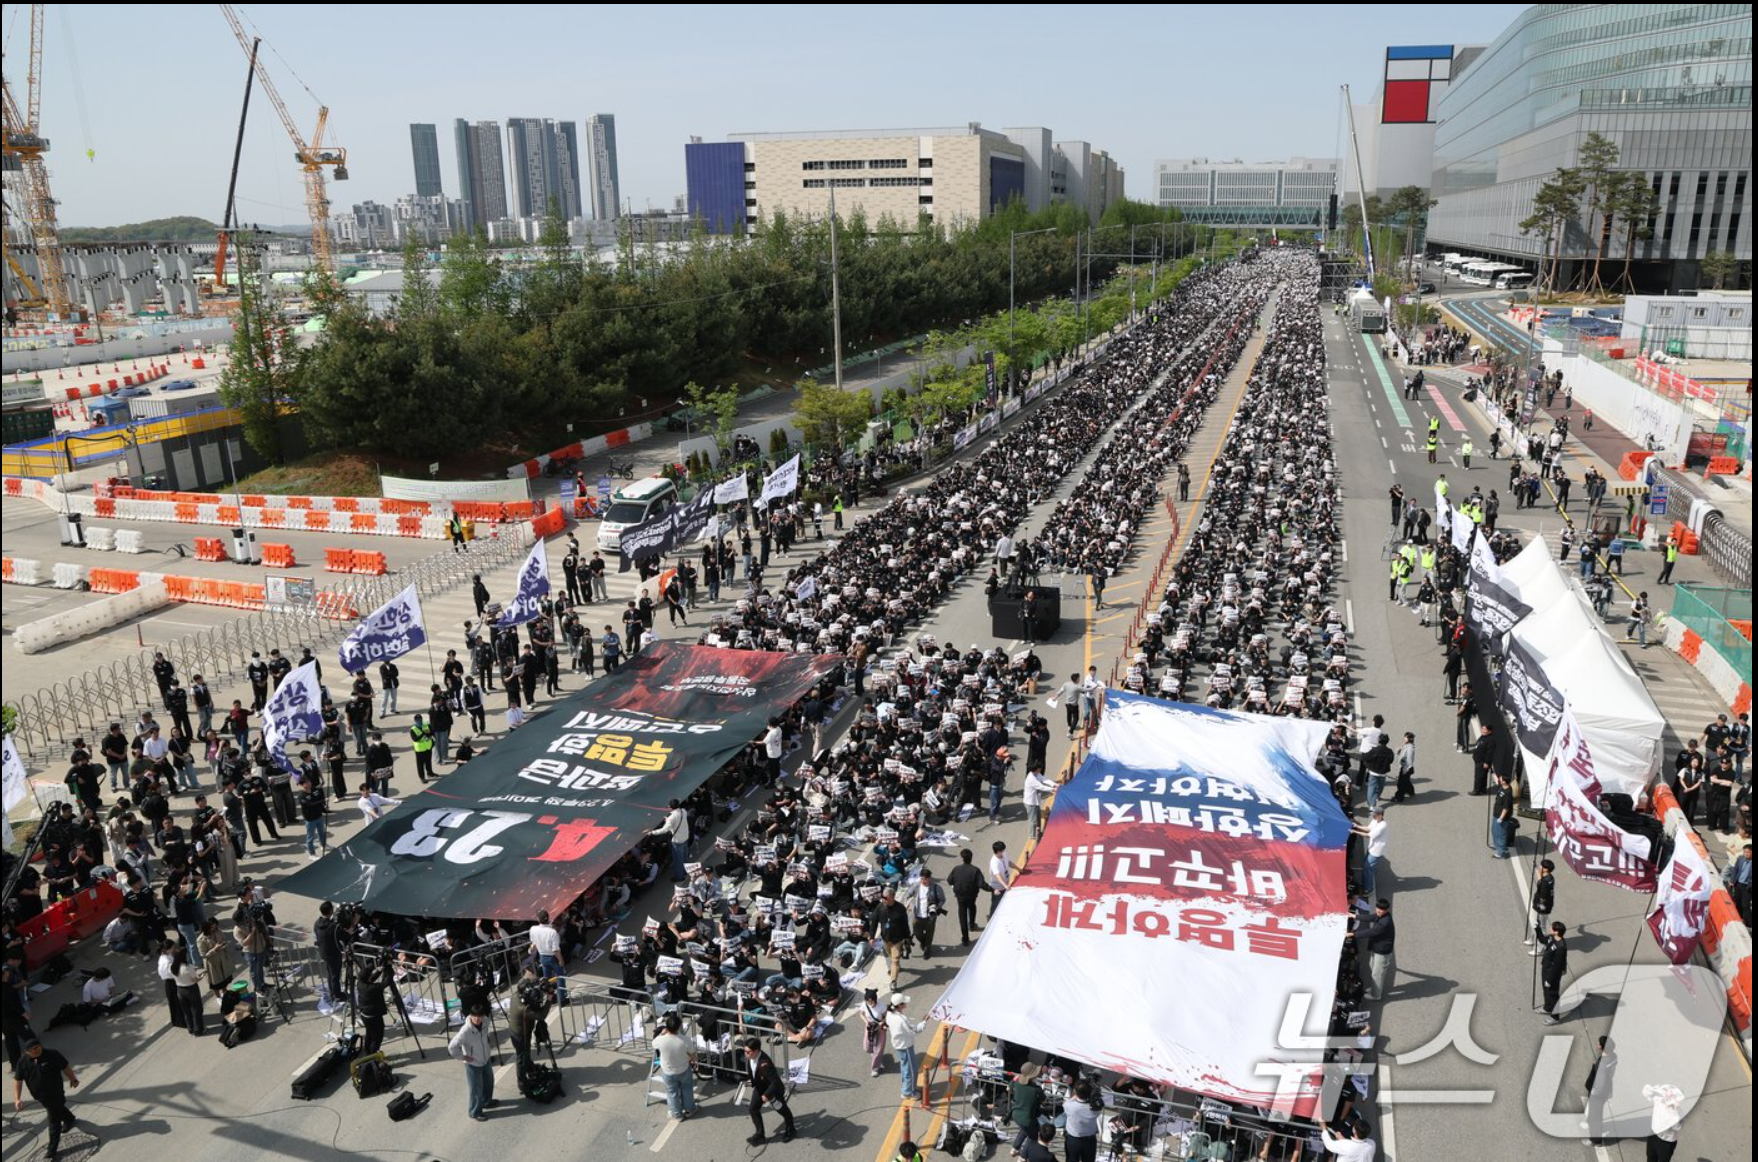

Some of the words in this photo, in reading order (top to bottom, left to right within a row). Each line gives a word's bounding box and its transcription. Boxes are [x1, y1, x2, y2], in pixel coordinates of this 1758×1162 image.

[546, 731, 674, 771] 투명화
[389, 806, 619, 864] 4.23
[1085, 797, 1310, 843] 상한폐지
[1055, 844, 1287, 900] 바꾸고!!!
[1041, 894, 1303, 961] 투명하게
